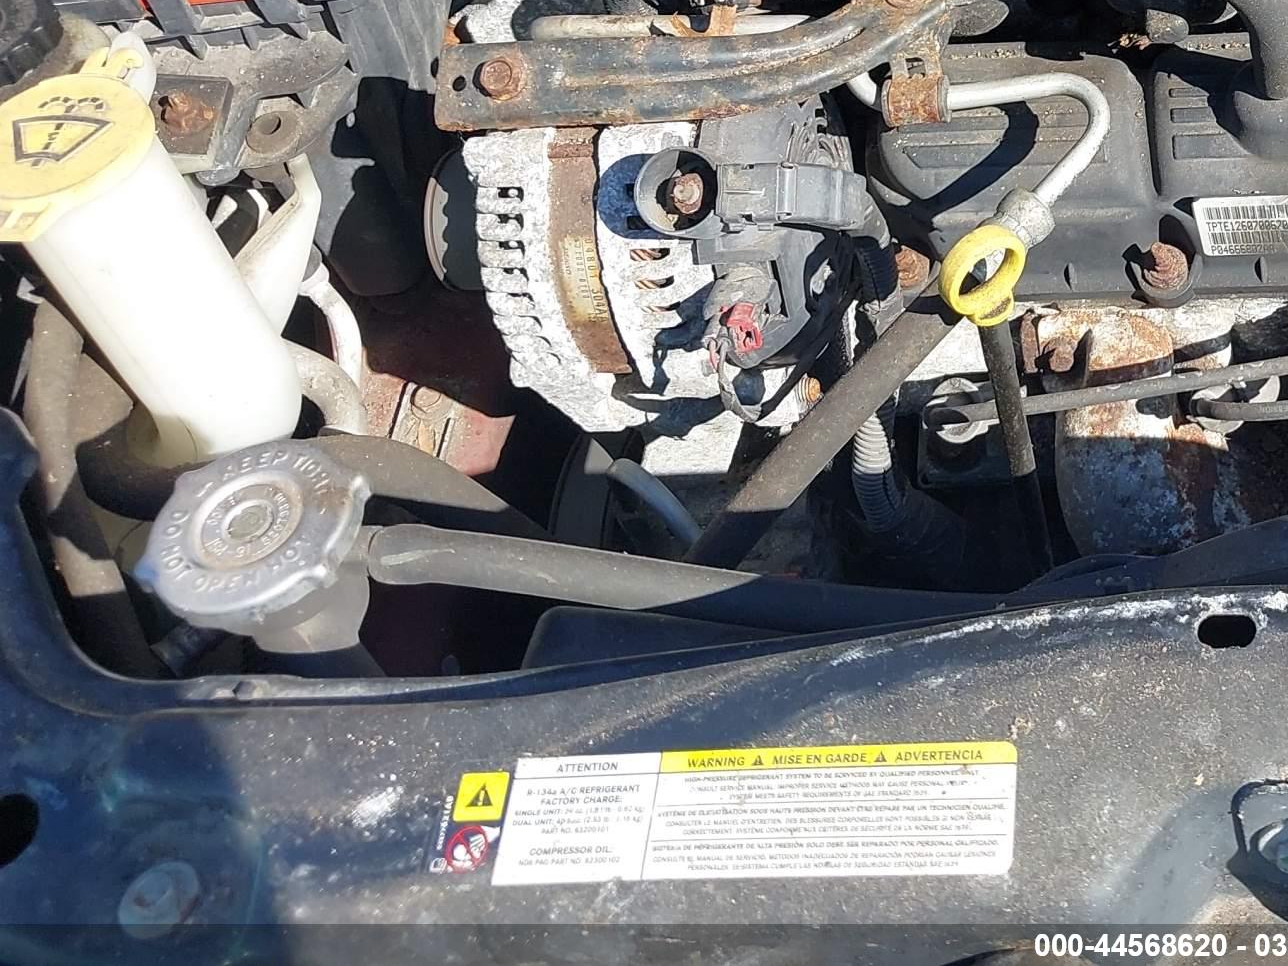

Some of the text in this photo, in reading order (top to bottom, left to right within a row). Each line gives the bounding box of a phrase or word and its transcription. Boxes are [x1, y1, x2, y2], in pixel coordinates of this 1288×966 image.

[687, 749, 983, 768] WARNING MISE EN GARDE ADVERTENCIA
[556, 761, 619, 774] ATTENTION
[560, 785, 577, 795] A/C
[579, 783, 640, 795] REFRIGERANT
[540, 795, 580, 805] FACTORY
[514, 808, 541, 816] SINGLE
[512, 819, 532, 827] DUAL
[529, 846, 593, 857] COMPRESSOR
